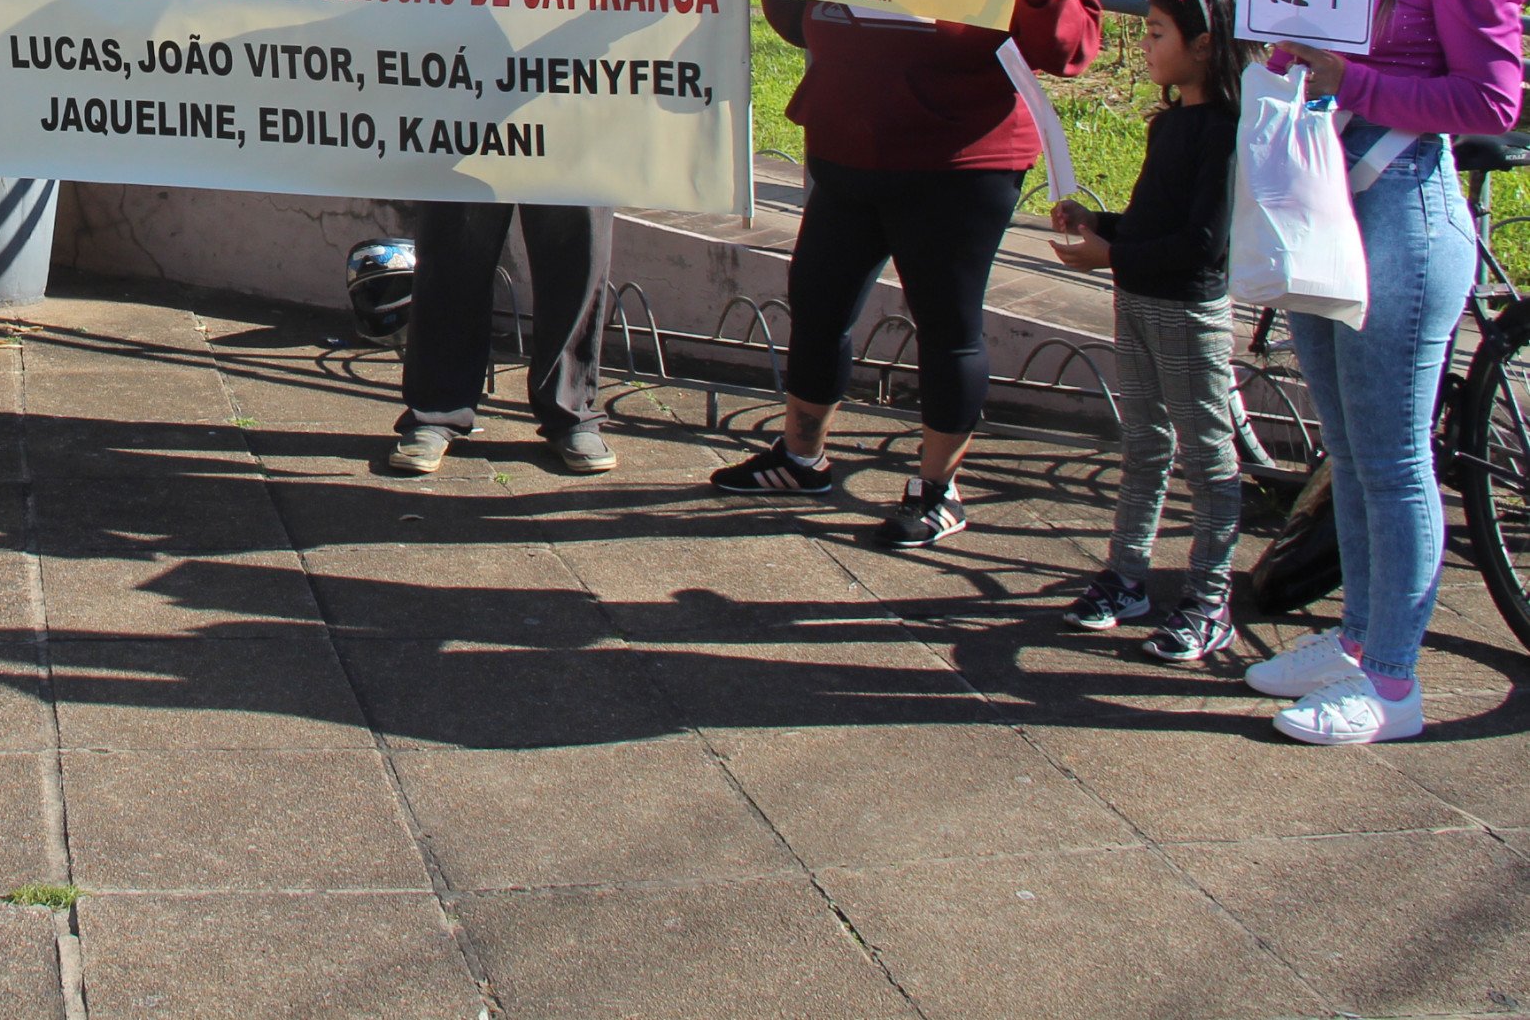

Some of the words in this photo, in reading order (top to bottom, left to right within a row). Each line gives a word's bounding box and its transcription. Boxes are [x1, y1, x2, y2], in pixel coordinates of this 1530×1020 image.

[10, 35, 131, 80] LUCAS,
[137, 34, 233, 77] JOÃO
[244, 43, 365, 91] VITOR,
[377, 45, 483, 99] ELOÁ,
[496, 57, 713, 106] JHENYFER,
[41, 96, 245, 149] JAQUELINE,
[260, 107, 386, 160] EDILIO,
[398, 116, 545, 157] KAUANI
